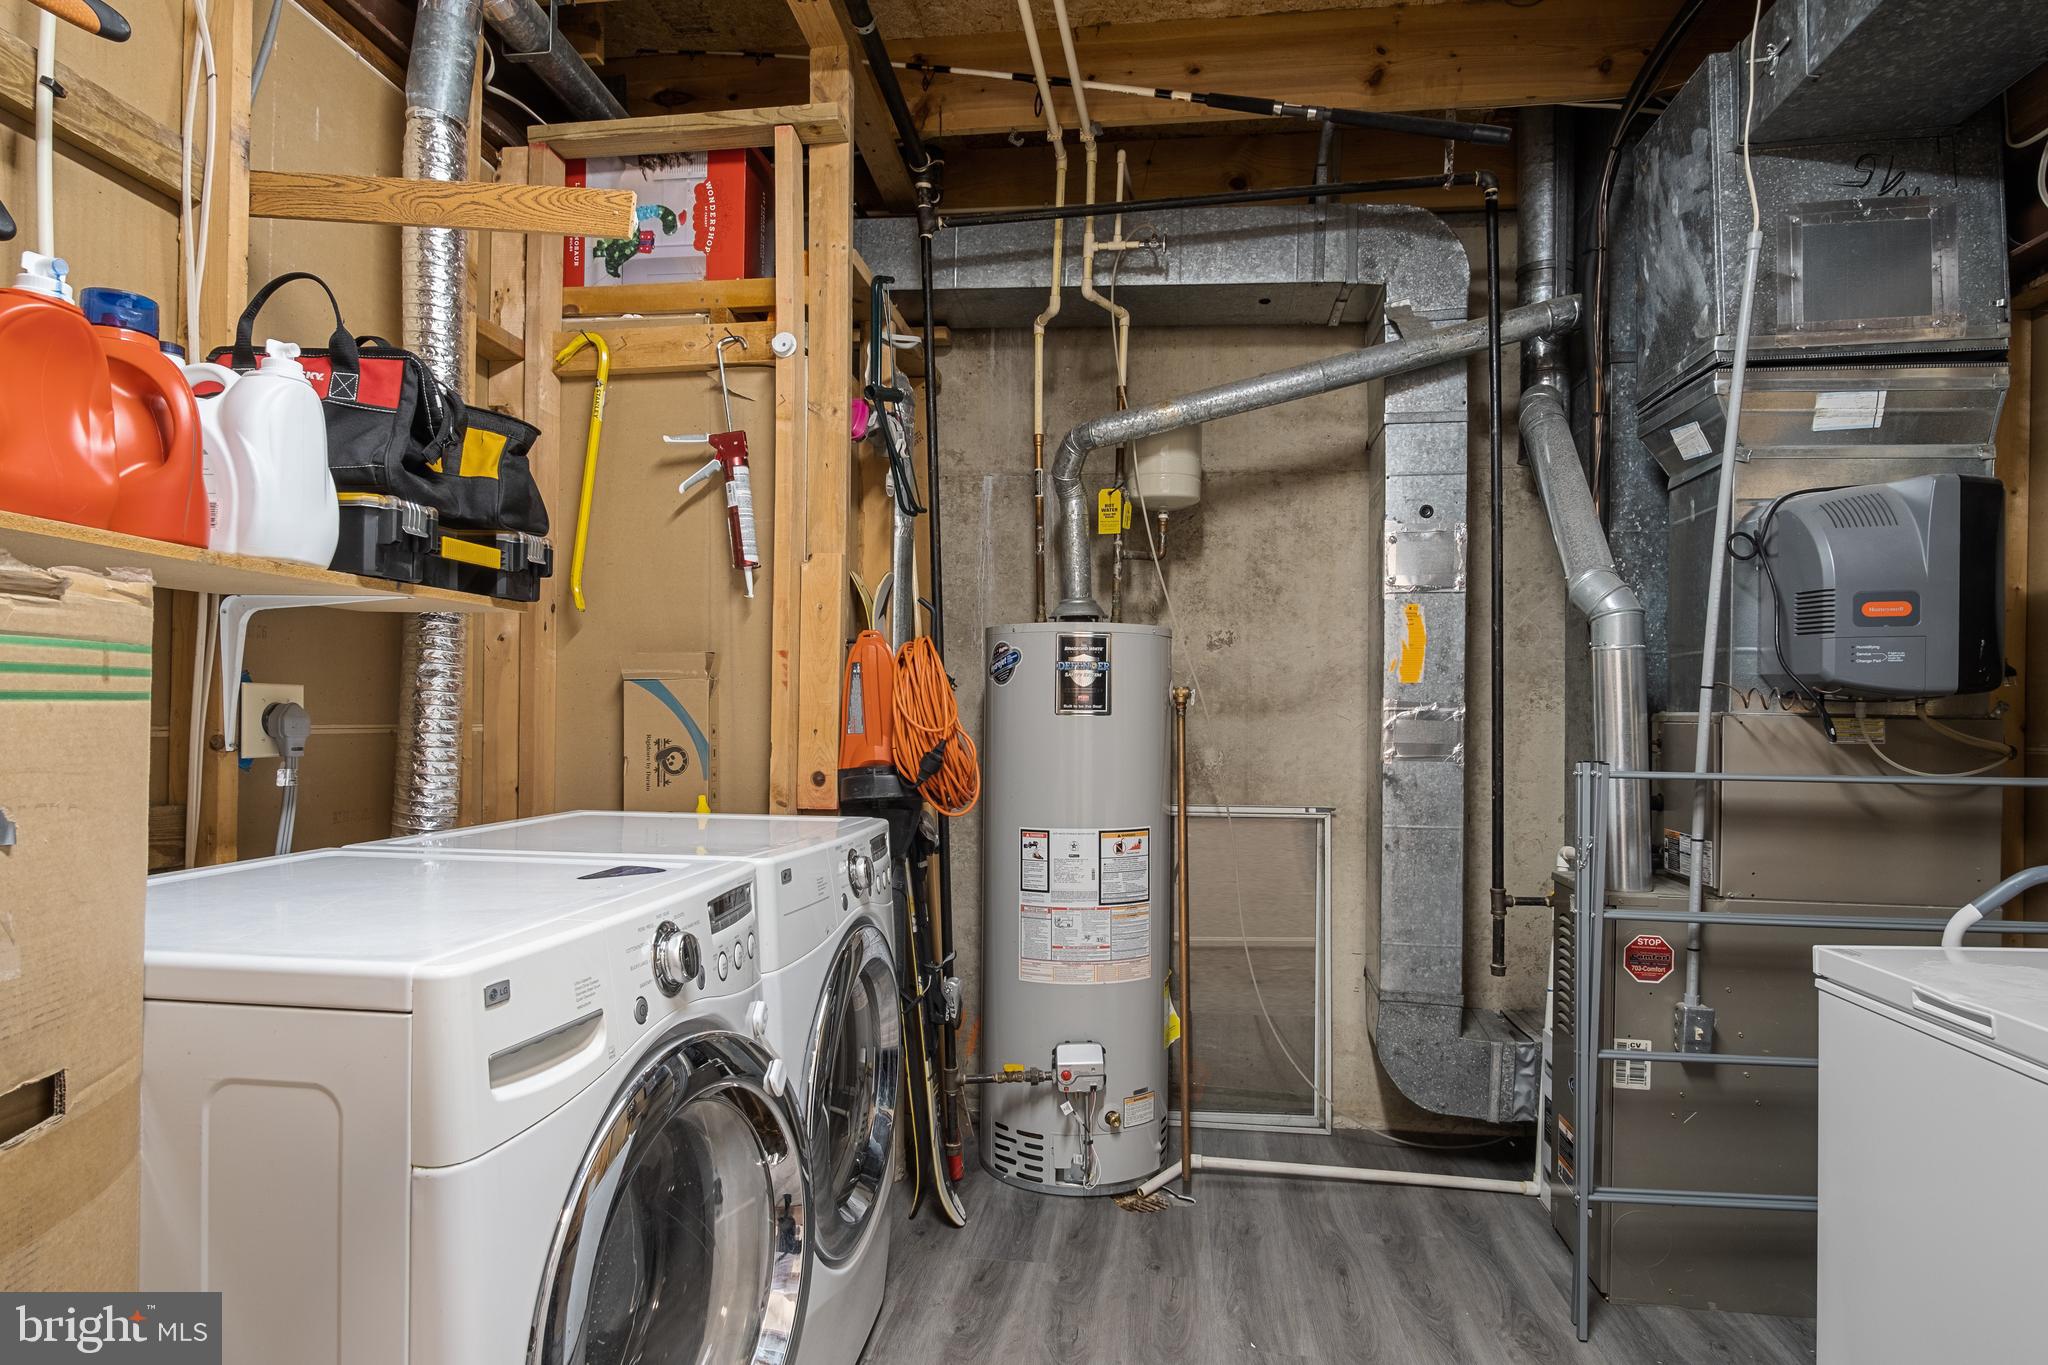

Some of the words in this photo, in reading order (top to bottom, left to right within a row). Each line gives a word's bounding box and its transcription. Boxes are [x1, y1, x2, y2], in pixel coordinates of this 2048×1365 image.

[705, 181, 716, 253] WONDERSHOP
[593, 389, 601, 418] STANLEY
[1057, 661, 1109, 671] DEFENDER
[1637, 937, 1662, 946] STOP
[1631, 965, 1666, 973] 703-Comfort
[499, 986, 508, 996] LG
